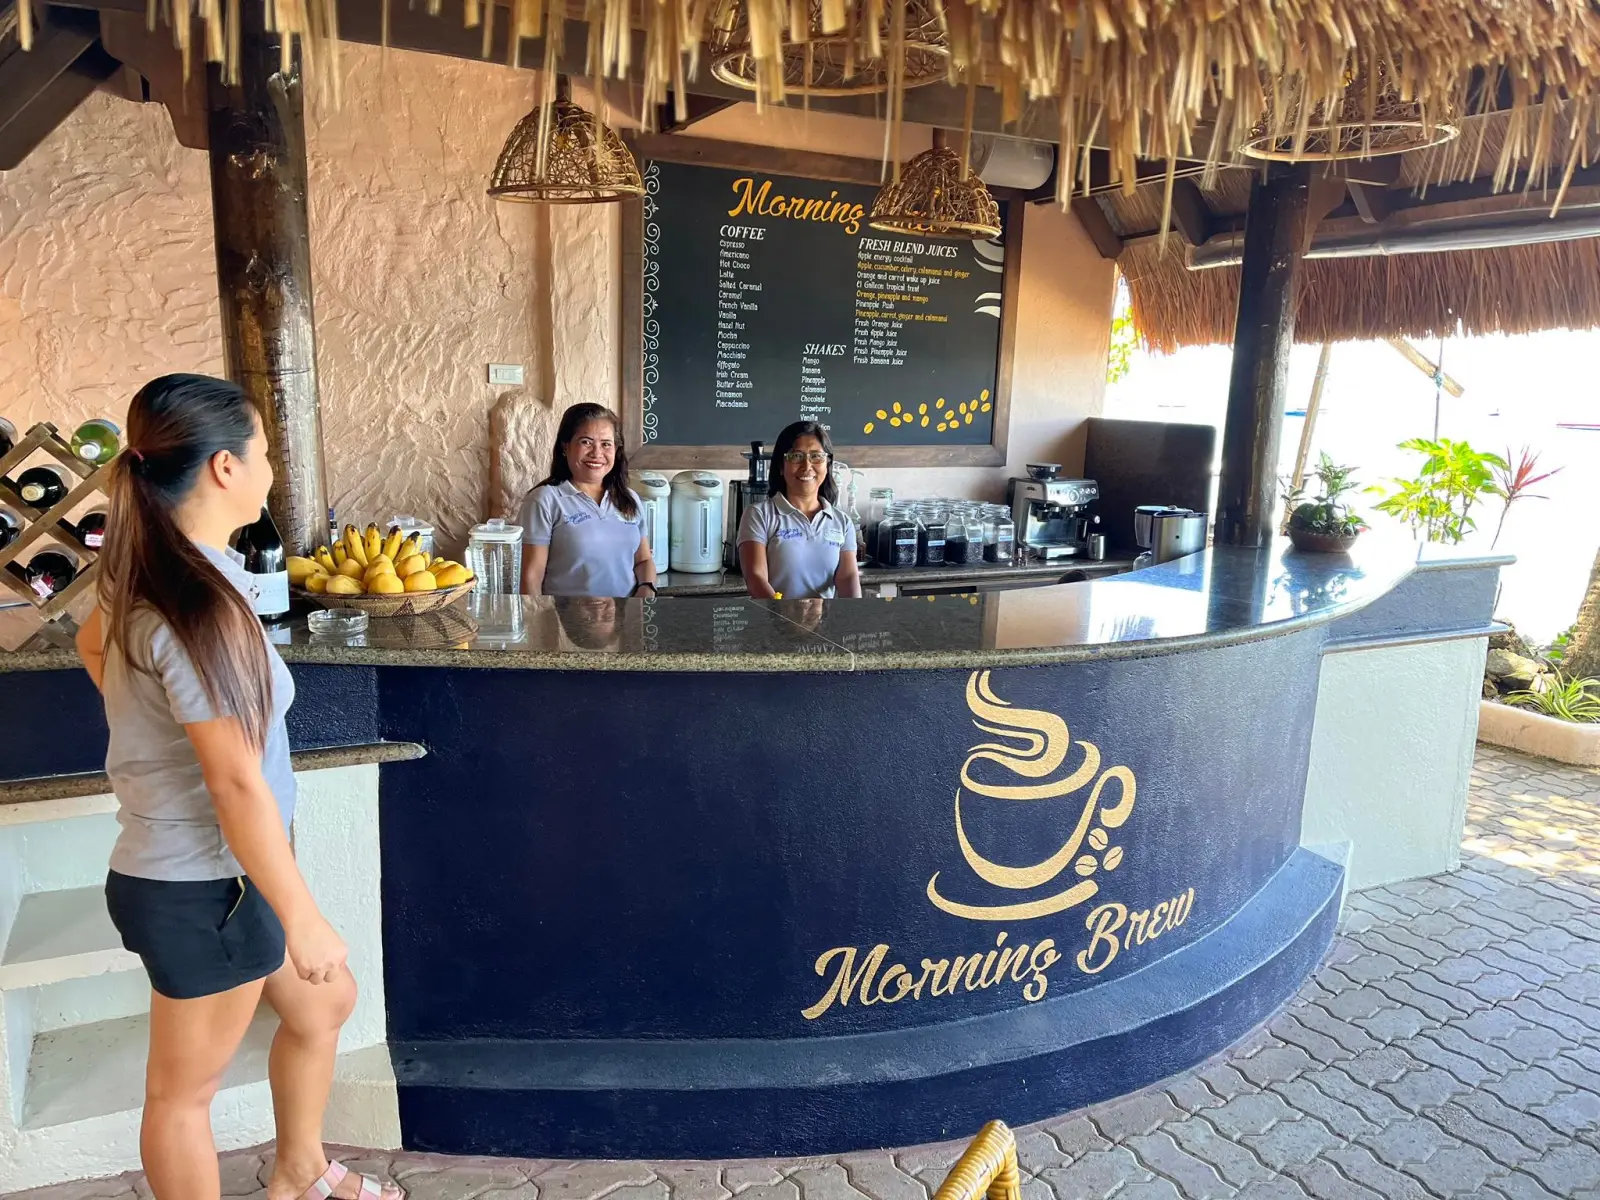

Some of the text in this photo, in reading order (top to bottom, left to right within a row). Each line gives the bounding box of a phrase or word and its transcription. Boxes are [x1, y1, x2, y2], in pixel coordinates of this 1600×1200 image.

[727, 178, 866, 235] Morning
[719, 224, 767, 241] COFFEE
[719, 239, 746, 249] Espresso
[858, 237, 959, 258] FRESH BLEND JUICES
[719, 249, 750, 260] Americano
[857, 251, 914, 264] Apple energy cocktail
[719, 259, 751, 270] Hot Choco
[719, 269, 735, 279] Latte
[856, 271, 941, 286] Orange and carrot wake up juice
[943, 269, 953, 277] and
[954, 270, 970, 279] ginger
[718, 280, 763, 291] Salted Caramel
[863, 280, 884, 290] Galleon
[886, 282, 905, 292] tropical
[907, 284, 920, 293] treat
[718, 290, 743, 300] Caramel
[877, 292, 901, 302] pineapple
[901, 293, 911, 301] and
[912, 295, 929, 304] mango
[718, 300, 758, 311] French Vanilla
[855, 299, 880, 310] Pineapple
[718, 311, 737, 319] Vanilla
[898, 312, 914, 321] ginger
[915, 313, 924, 321] and
[718, 321, 745, 330] Hazel Nut
[854, 318, 903, 329] Fresh Orange Juice
[717, 331, 738, 339] Mocha
[854, 327, 869, 336] Fresh
[870, 329, 884, 338] Apple
[717, 341, 751, 351] Cappuccino
[854, 337, 867, 346] Fresh
[869, 338, 885, 347] Mango
[802, 343, 847, 356] SHAKES
[853, 346, 868, 355] Fresh
[870, 347, 894, 357] Pineapple
[716, 351, 747, 359] Macchiato
[853, 355, 868, 364] Fresh
[870, 356, 890, 364] Banana
[716, 360, 740, 370] Affogato
[802, 357, 820, 366] Mango
[730, 371, 749, 379] Cream
[801, 366, 821, 374] Banana
[716, 380, 753, 389] Butter Scotch
[801, 376, 826, 386] Pineapple
[715, 390, 743, 398] Cinnamon
[800, 385, 827, 393] Calamansi
[715, 400, 749, 408] Macadamia
[800, 395, 826, 403] Chocolate
[800, 404, 832, 414] Strawberry
[800, 413, 819, 422] Vanilla
[800, 887, 1196, 1020] Morning Brew
